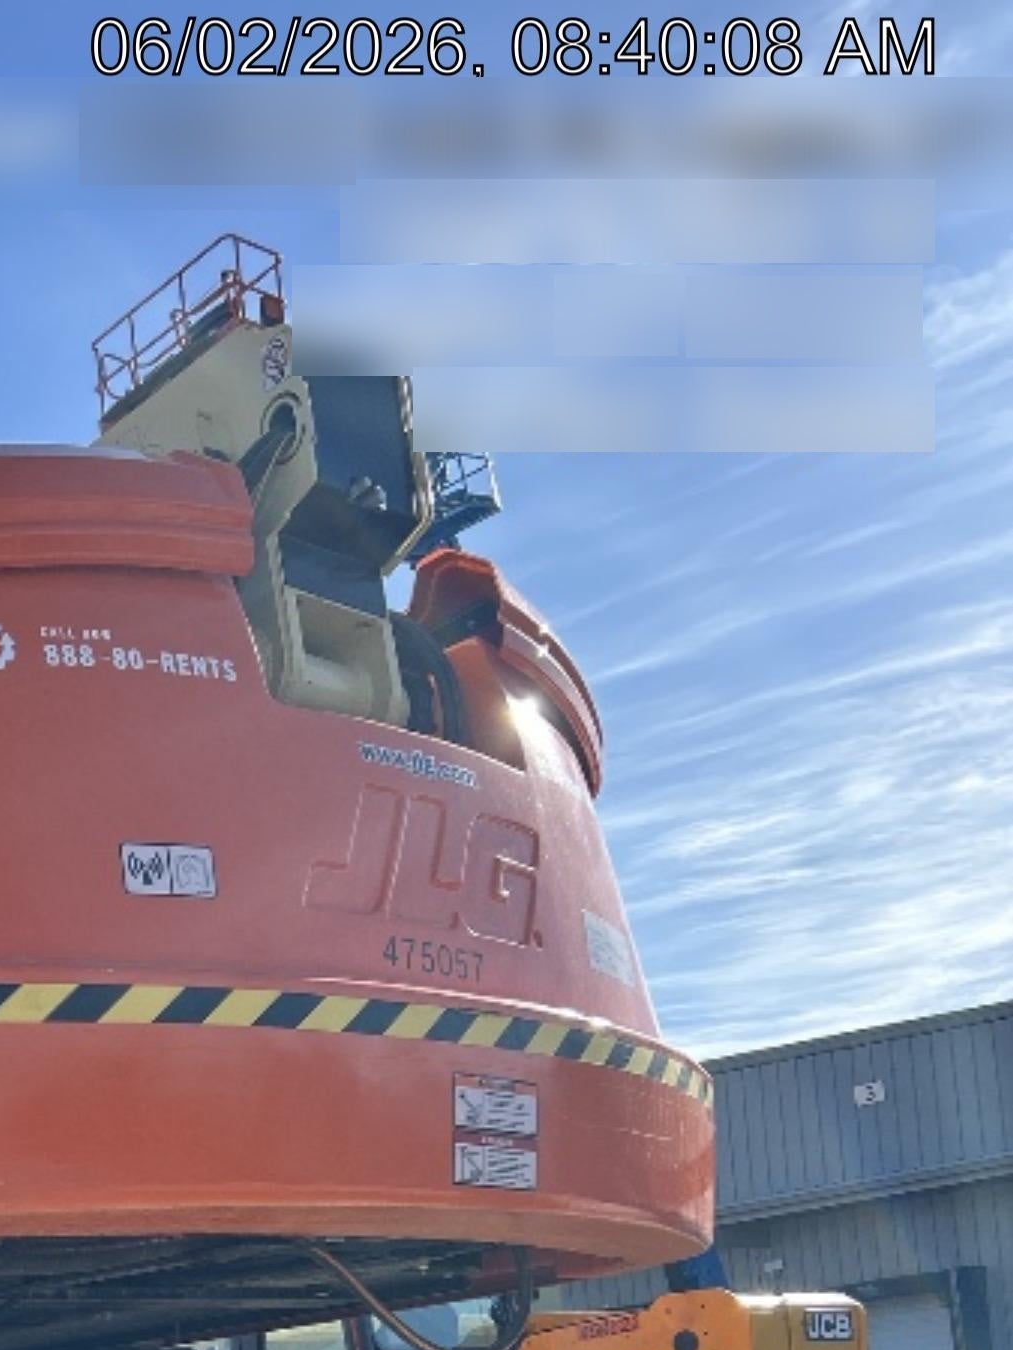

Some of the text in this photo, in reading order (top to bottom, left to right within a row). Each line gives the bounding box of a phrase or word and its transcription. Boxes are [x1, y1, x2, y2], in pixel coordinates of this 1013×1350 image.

[301, 783, 541, 950] JLG
[383, 935, 483, 983] 475057
[865, 1085, 877, 1102] 3
[807, 1312, 853, 1339] JCB
